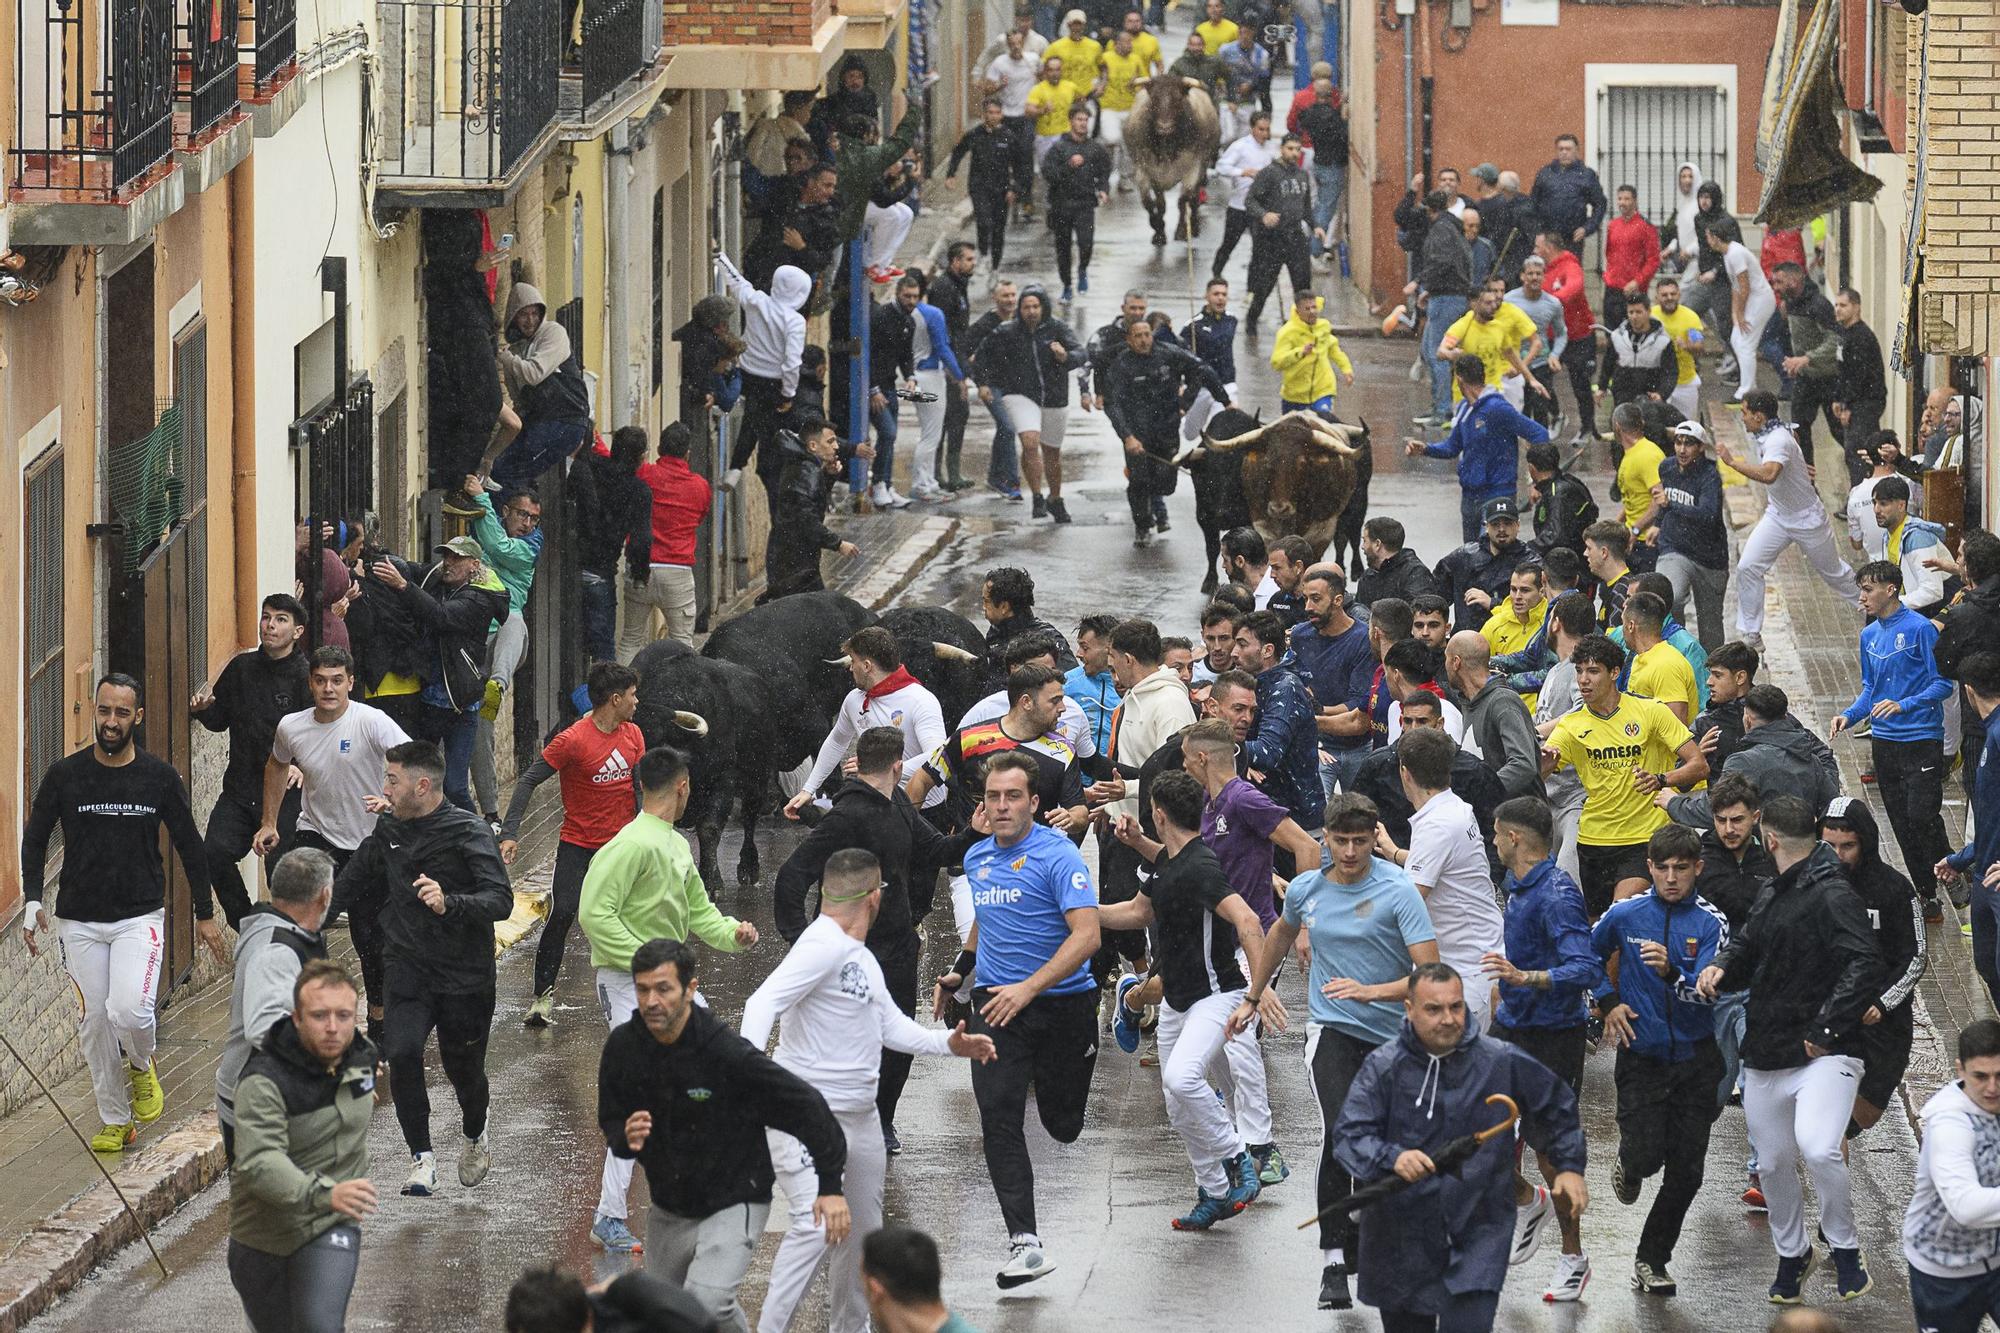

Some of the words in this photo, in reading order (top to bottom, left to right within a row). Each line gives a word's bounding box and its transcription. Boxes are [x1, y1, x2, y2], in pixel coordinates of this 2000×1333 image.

[1585, 745, 1642, 760] PAMESA
[592, 768, 632, 783] adidas
[78, 803, 133, 812] ESPECTÁCULOS
[134, 805, 157, 814] BLANCO
[974, 885, 1022, 906] satine
